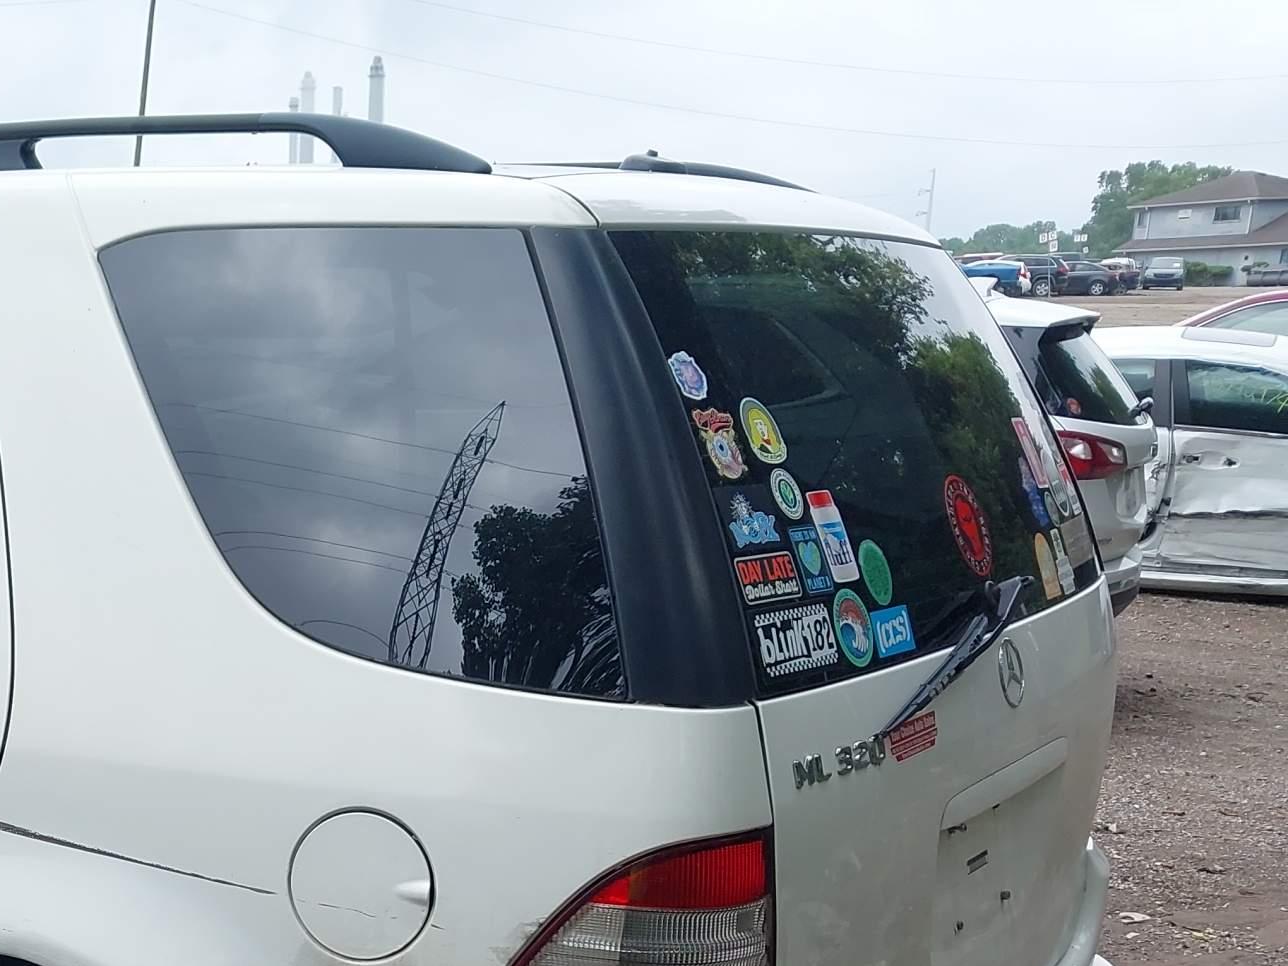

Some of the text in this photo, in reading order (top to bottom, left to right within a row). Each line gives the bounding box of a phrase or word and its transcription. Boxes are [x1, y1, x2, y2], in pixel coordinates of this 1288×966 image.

[738, 555, 794, 585] DAY LATE
[745, 578, 799, 600] Dollar Short
[792, 734, 887, 790] ML 320
